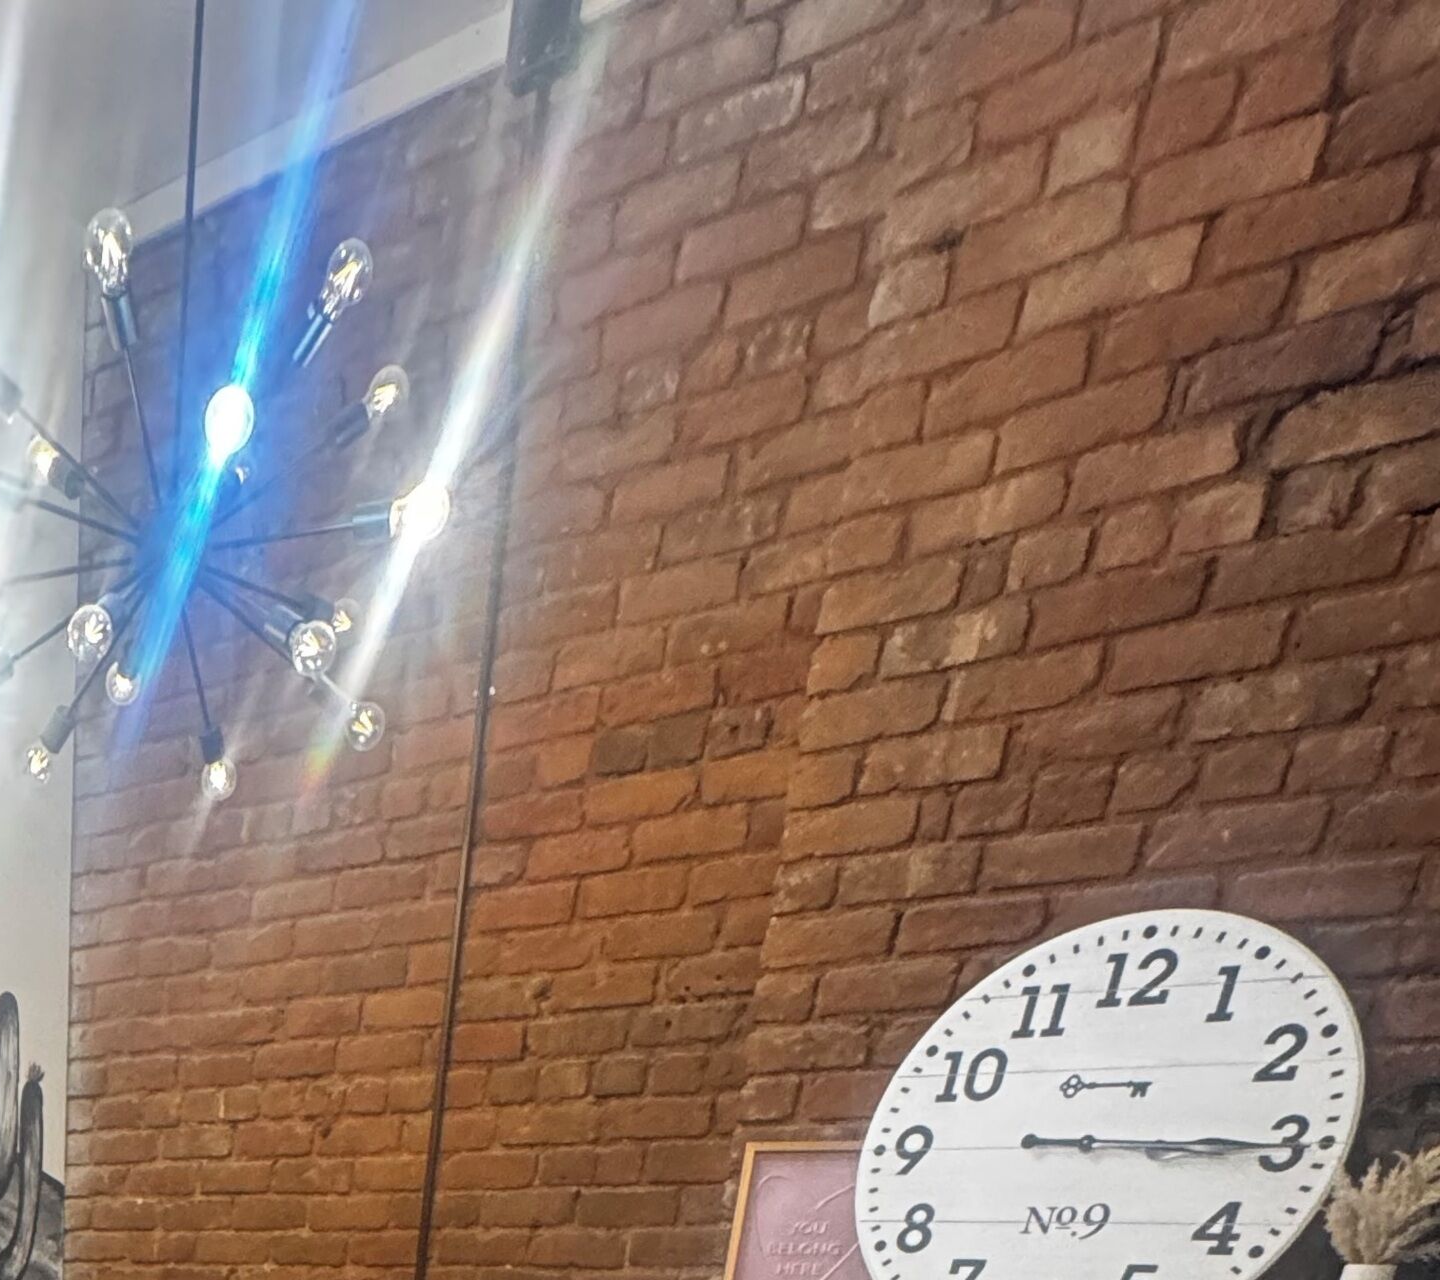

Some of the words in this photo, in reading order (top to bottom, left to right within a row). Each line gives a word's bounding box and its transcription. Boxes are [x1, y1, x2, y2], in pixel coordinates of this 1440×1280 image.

[1095, 948, 1178, 1008] 12
[1205, 964, 1241, 1022] 1
[1011, 982, 1070, 1039] 11
[934, 1047, 1008, 1103] 10
[1253, 1023, 1308, 1082] 2
[896, 1124, 934, 1176] 9
[1259, 1114, 1310, 1173] 3
[896, 1203, 935, 1254] 8
[1192, 1202, 1242, 1256] 4
